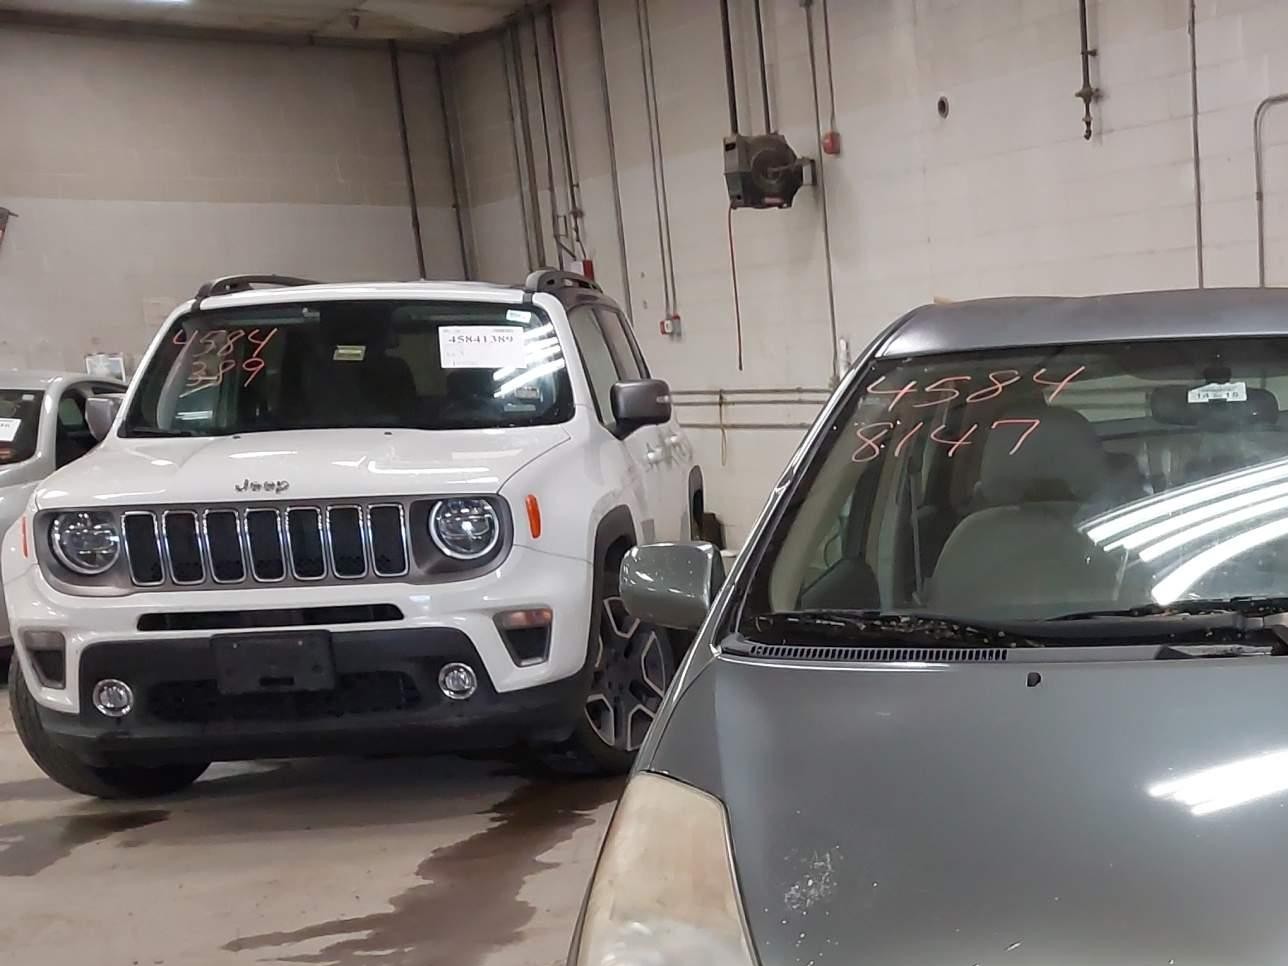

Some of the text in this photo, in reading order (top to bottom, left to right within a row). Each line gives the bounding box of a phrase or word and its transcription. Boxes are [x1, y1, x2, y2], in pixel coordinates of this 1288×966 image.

[173, 327, 278, 358] 4584
[866, 365, 1086, 412] 4584
[851, 418, 1041, 463] 8147
[235, 479, 290, 494] Jeep
